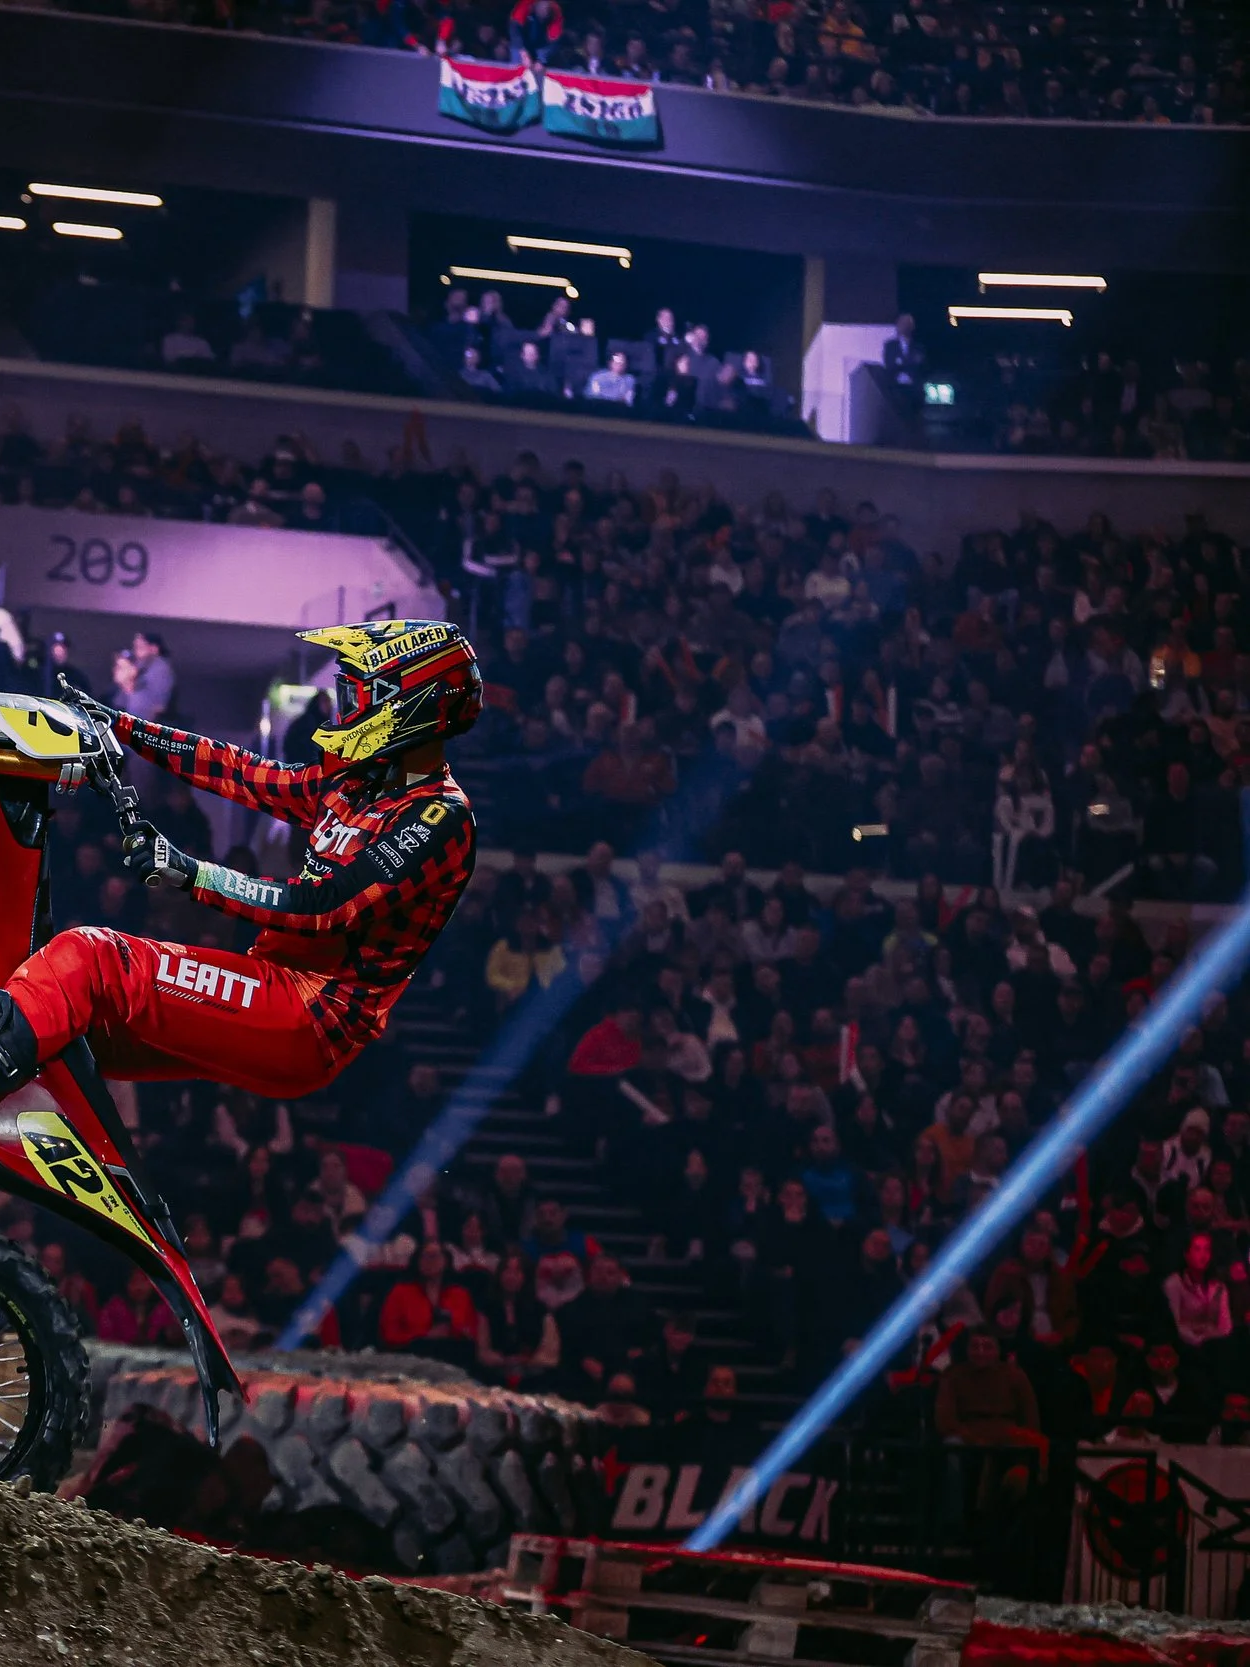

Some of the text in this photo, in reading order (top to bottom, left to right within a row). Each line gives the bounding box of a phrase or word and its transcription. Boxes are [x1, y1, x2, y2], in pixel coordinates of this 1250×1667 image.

[47, 535, 149, 588] 209
[133, 730, 159, 743] PETER
[341, 721, 375, 744] SVEDNECK
[381, 843, 402, 867] MARIN
[224, 871, 283, 907] LEATT
[156, 953, 261, 1009] LEATT
[23, 1131, 104, 1200] 42
[610, 1463, 840, 1546] BLACK
